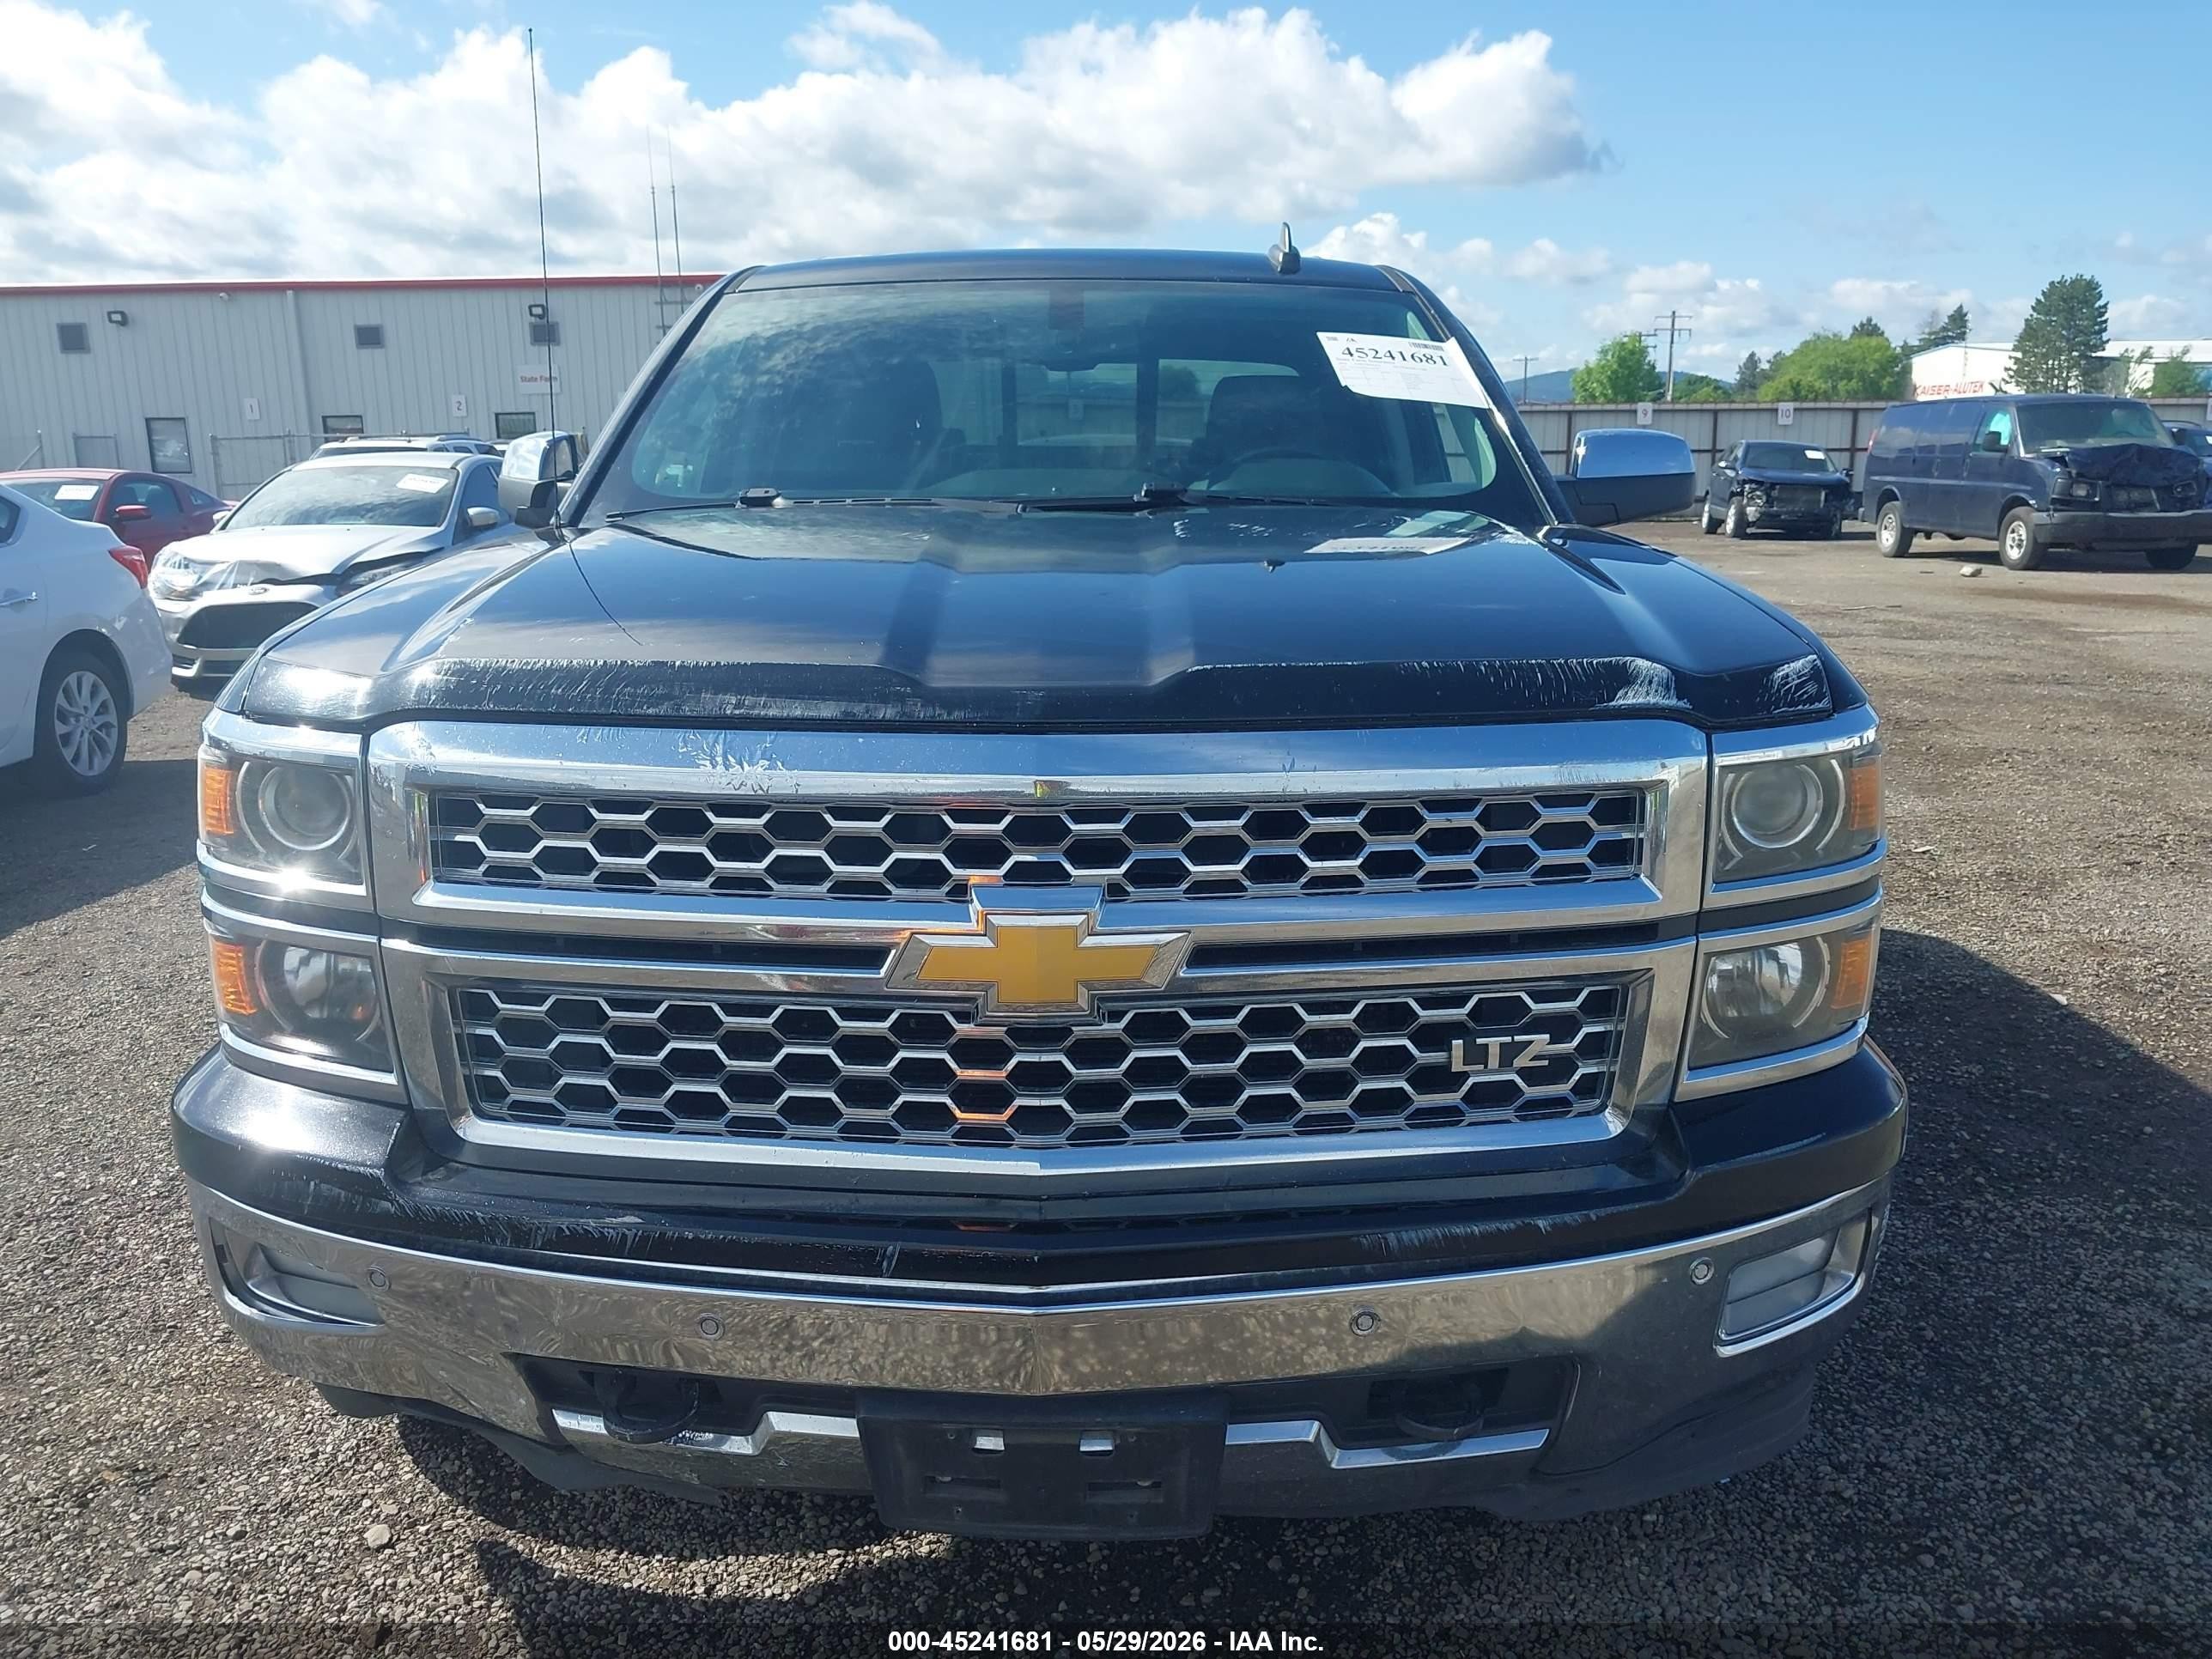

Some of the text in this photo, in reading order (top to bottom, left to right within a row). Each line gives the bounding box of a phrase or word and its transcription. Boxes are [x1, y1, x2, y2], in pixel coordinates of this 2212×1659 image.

[1341, 347, 1449, 367] 45241681
[455, 400, 462, 411] 2
[1641, 408, 1649, 419] 9
[1780, 408, 1791, 419] 10
[1451, 1034, 1550, 1072] LTZ
